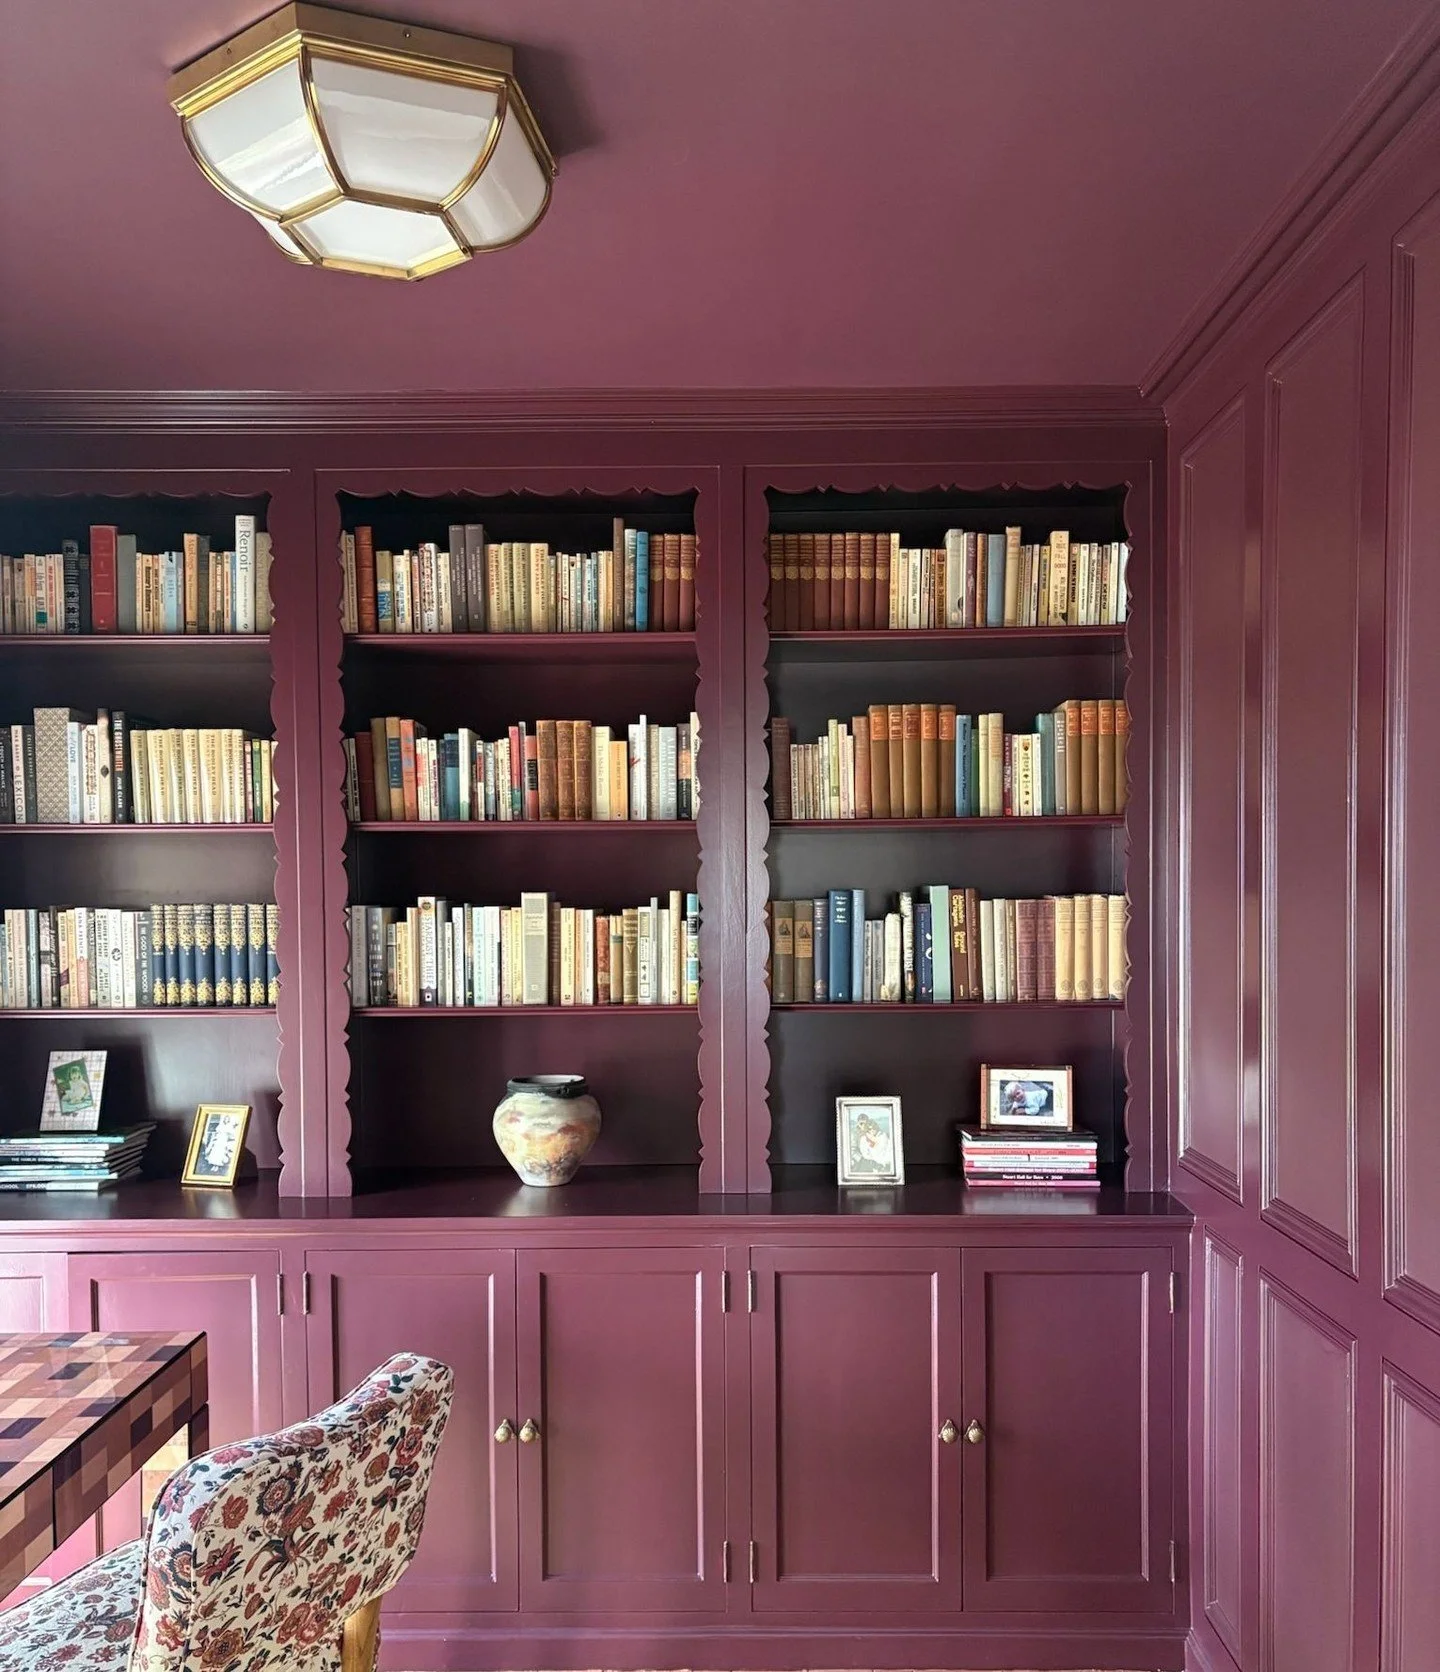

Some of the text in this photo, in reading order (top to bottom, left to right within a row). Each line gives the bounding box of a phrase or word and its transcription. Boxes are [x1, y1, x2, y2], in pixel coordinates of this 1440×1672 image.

[186, 538, 195, 570] Markings
[239, 530, 252, 572] Renoir
[114, 719, 122, 730] THE
[114, 731, 124, 772] GHOSTWRITER
[667, 745, 676, 780] LITTLE
[14, 775, 23, 821] LEXICON
[668, 781, 676, 804] LIFE
[425, 917, 435, 985] STARDUST THIEF
